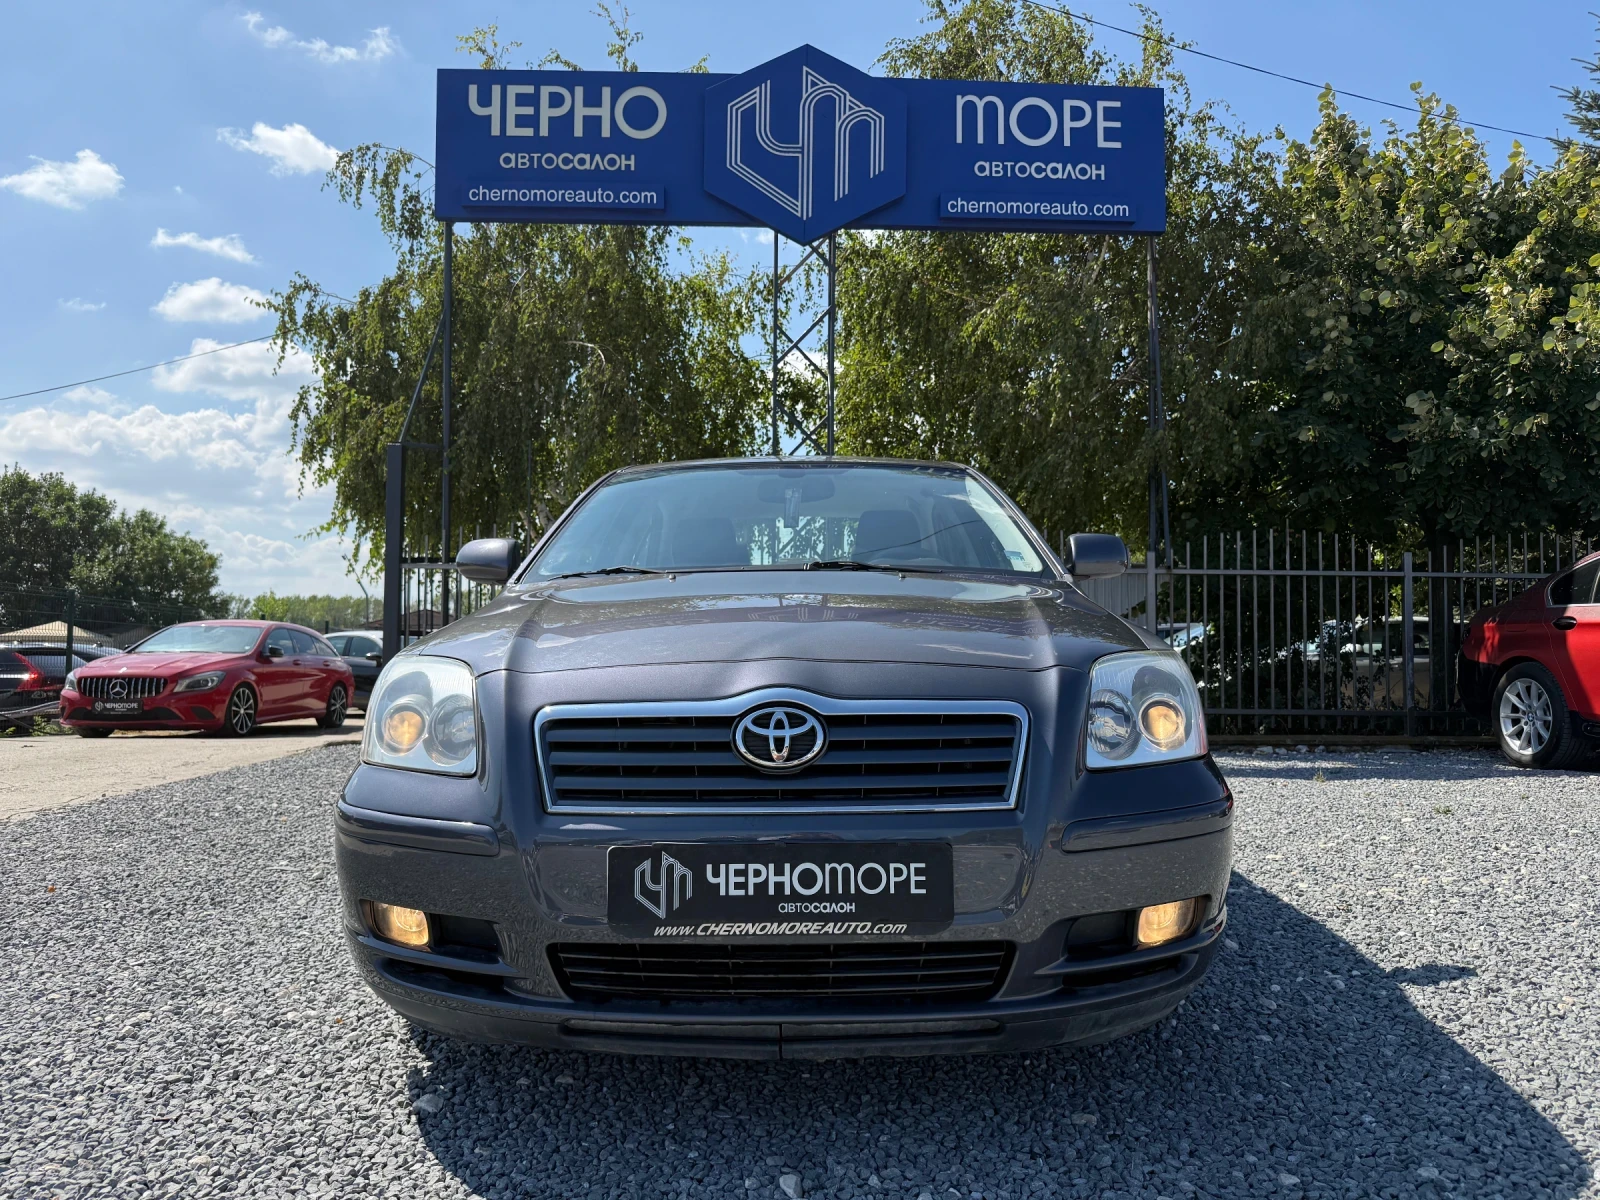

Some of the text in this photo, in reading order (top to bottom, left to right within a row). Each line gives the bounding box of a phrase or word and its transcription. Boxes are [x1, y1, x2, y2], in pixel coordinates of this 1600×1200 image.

[468, 84, 668, 139] ЧЕРНО
[956, 94, 1122, 149] МОРЕ
[468, 185, 657, 204] chernomoreauto.com
[947, 197, 1129, 217] chernomoreauto.com
[706, 862, 927, 896] ЧЕРНОМОРЕ
[653, 921, 908, 937] www.CHERNOMOREAUTO.com
